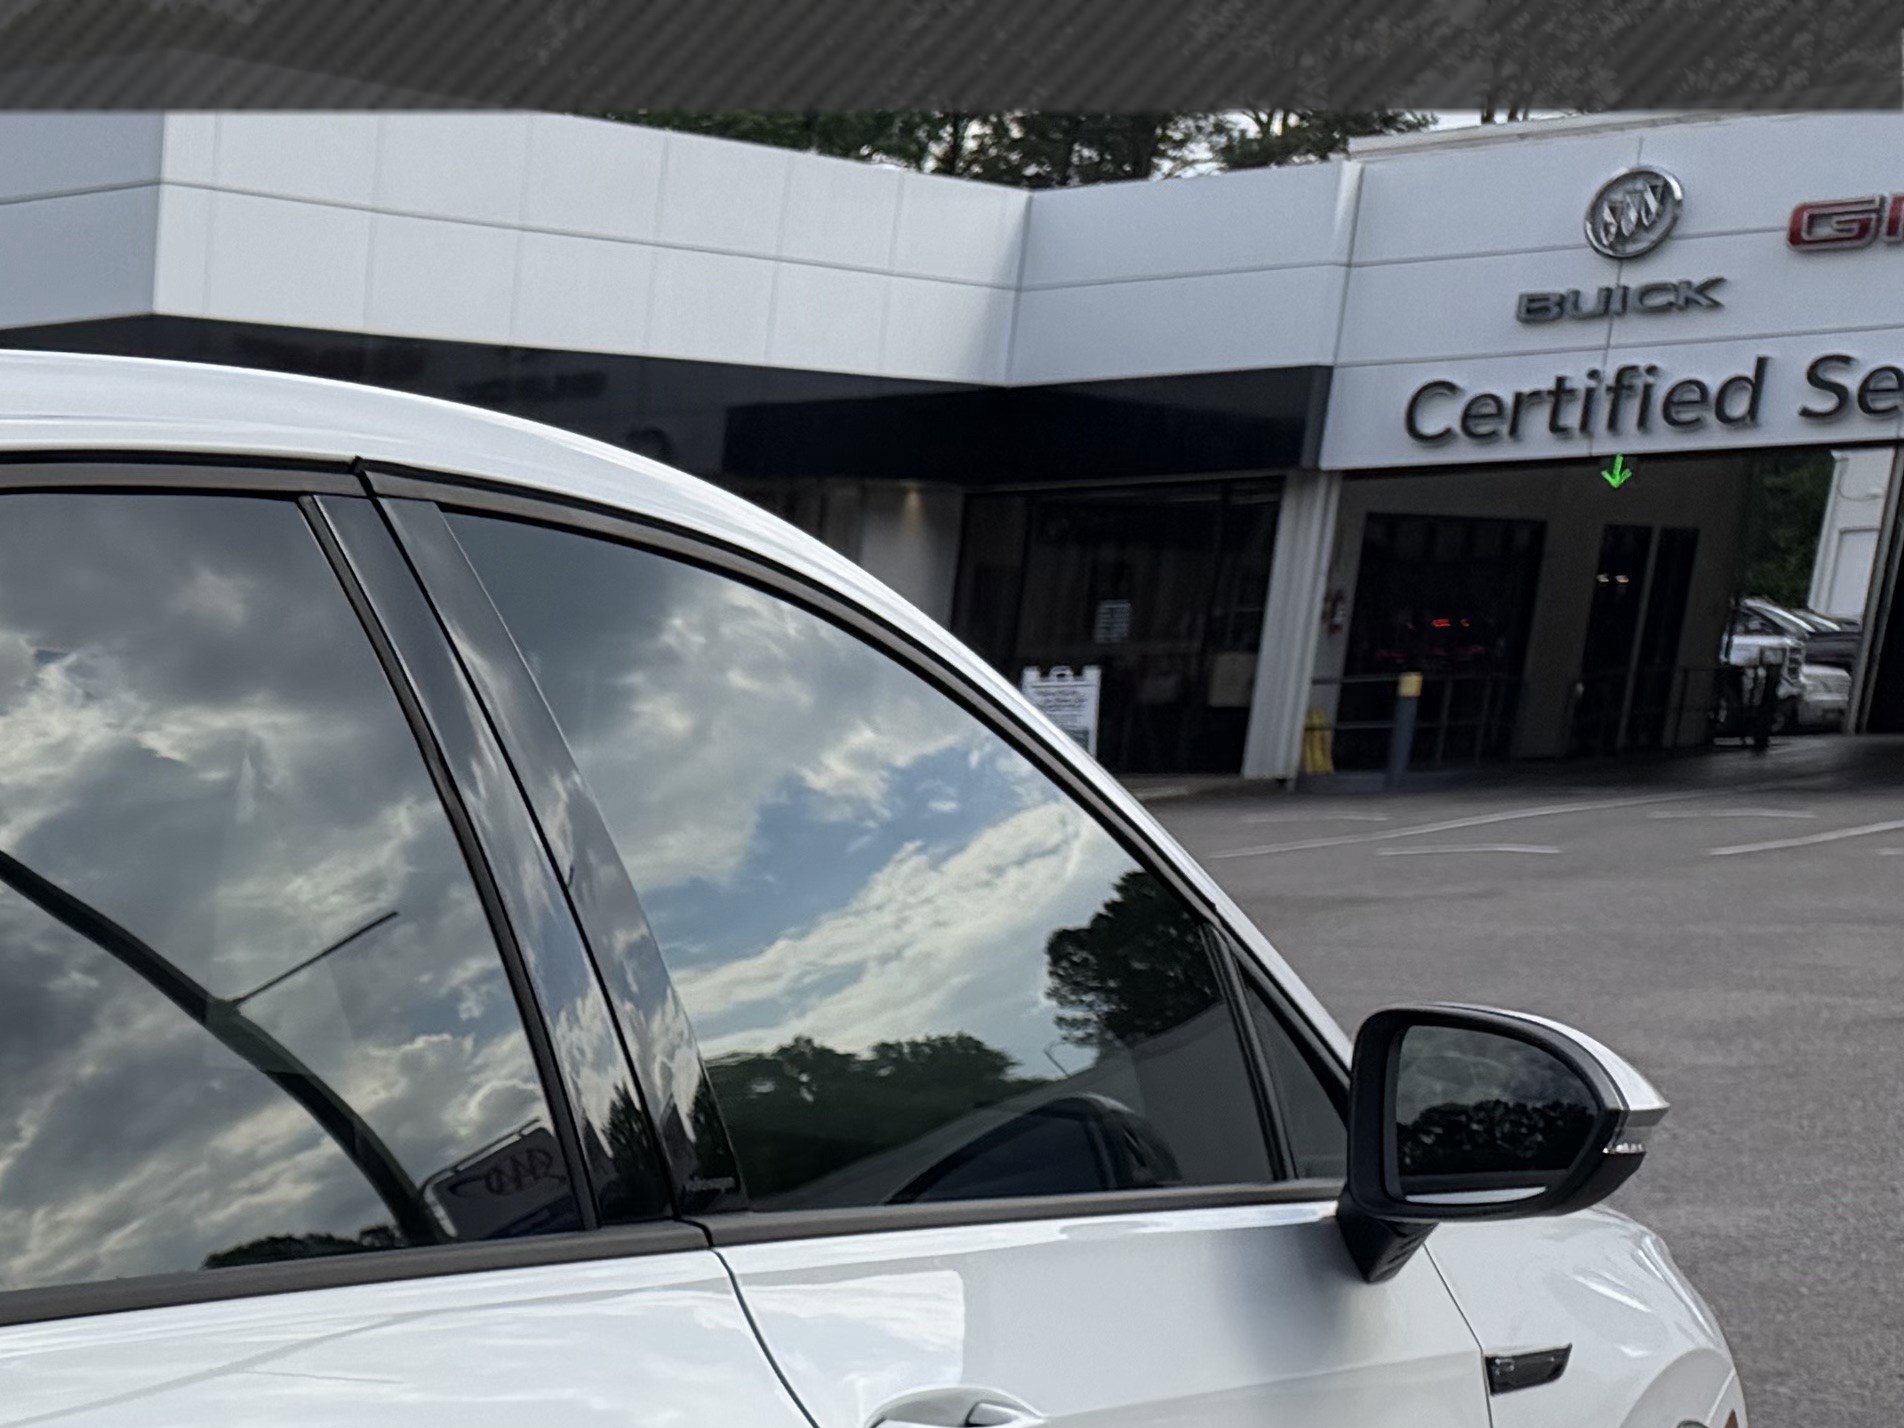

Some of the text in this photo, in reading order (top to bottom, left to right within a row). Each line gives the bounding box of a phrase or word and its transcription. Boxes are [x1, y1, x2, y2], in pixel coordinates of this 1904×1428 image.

[1515, 276, 1727, 325] BUICK
[1403, 353, 1904, 446] Certified Se
